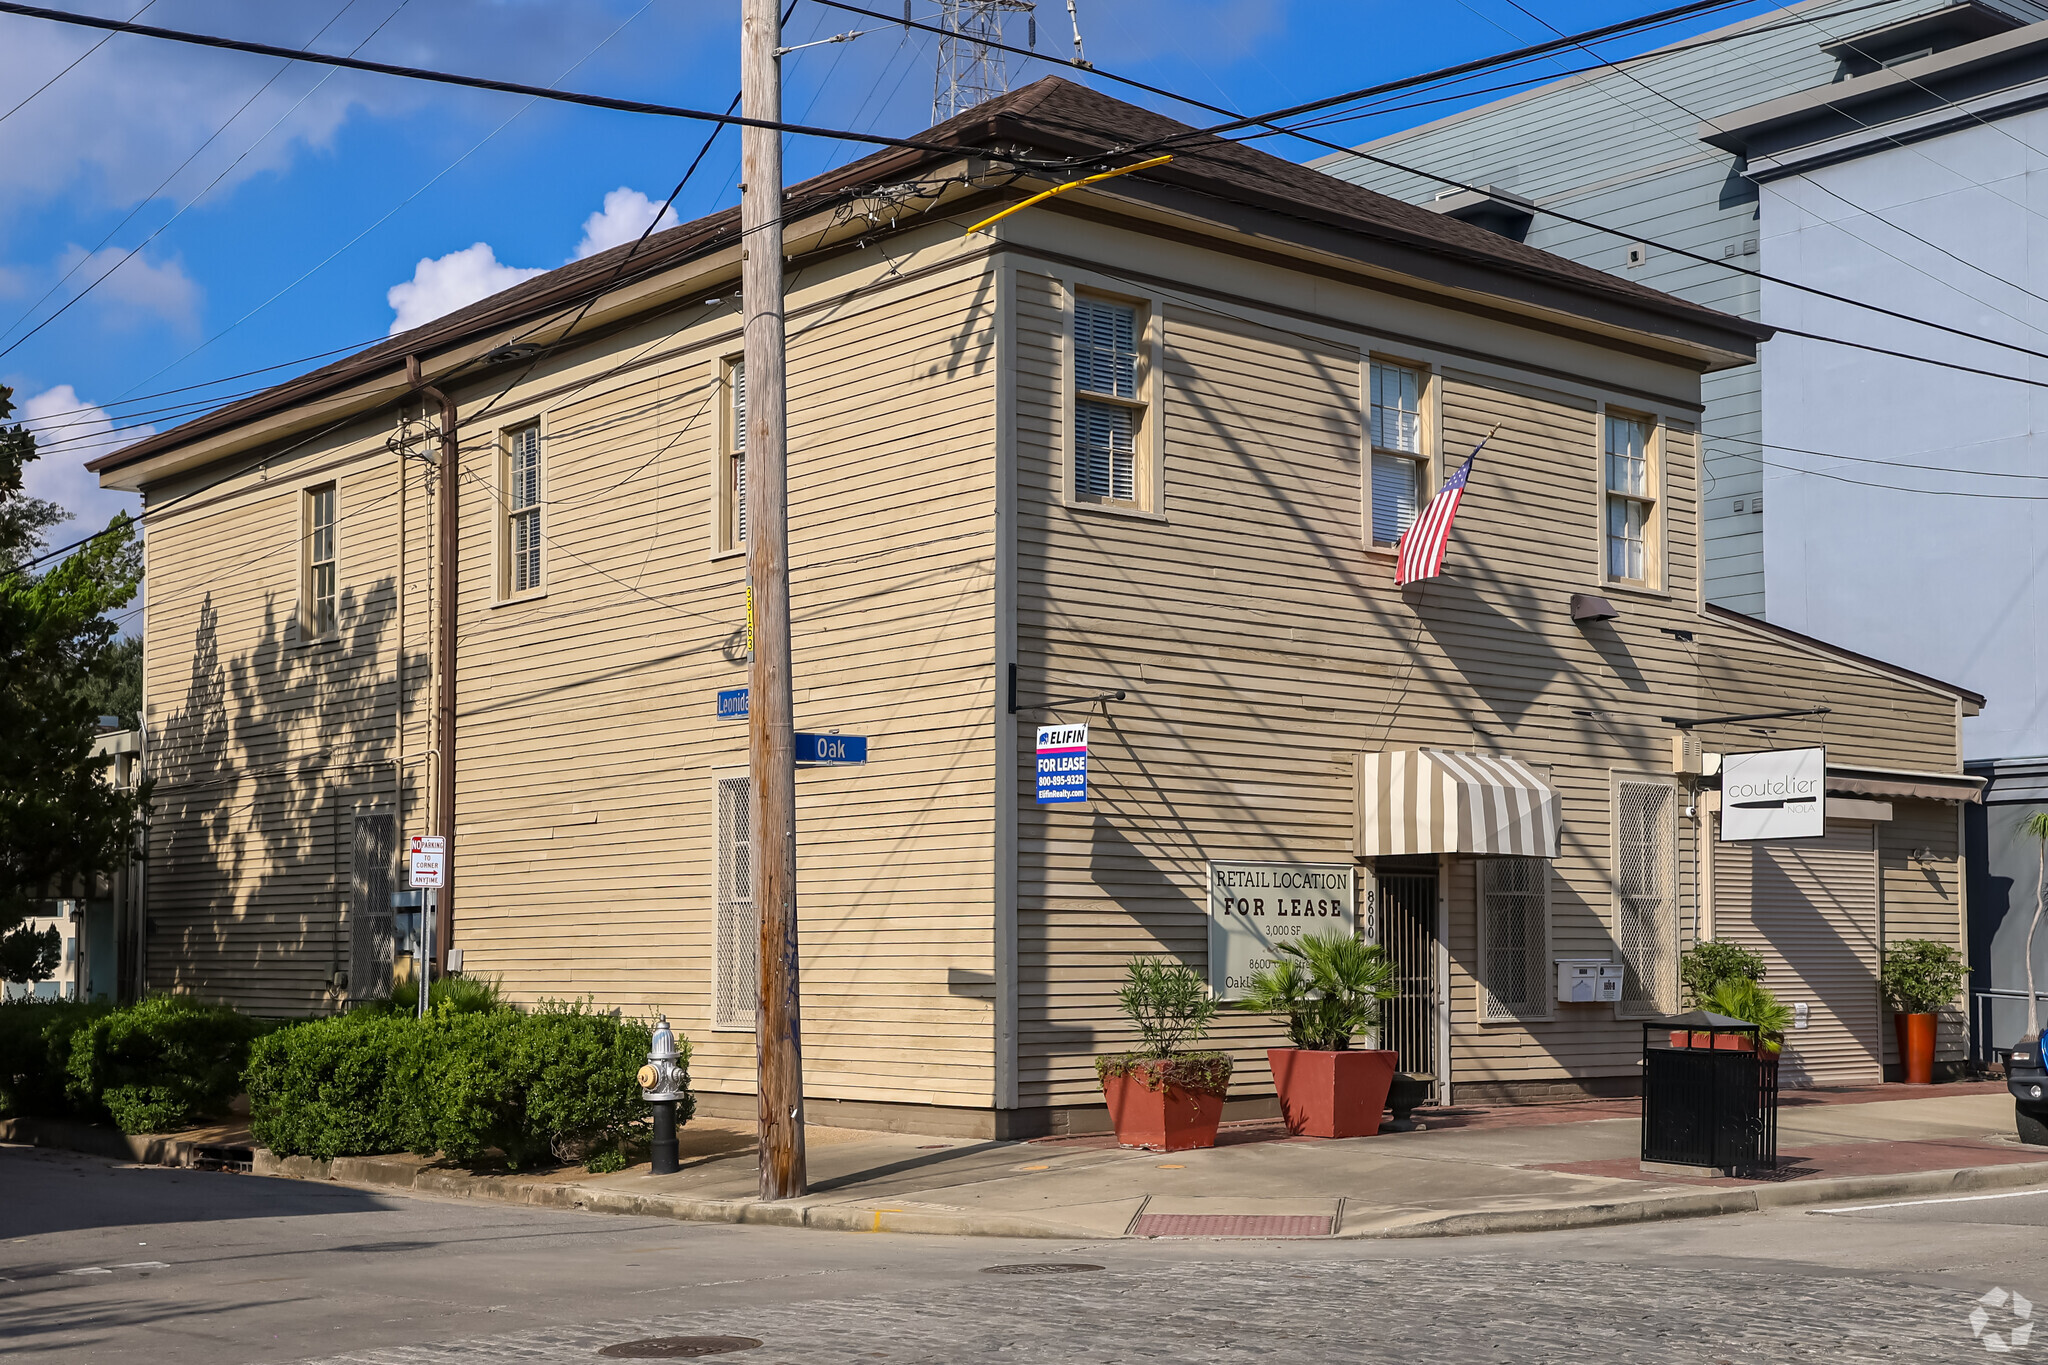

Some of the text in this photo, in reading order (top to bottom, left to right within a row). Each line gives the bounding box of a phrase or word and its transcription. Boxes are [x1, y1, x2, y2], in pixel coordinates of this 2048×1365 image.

[719, 693, 749, 714] Leonida
[1050, 730, 1085, 744] ELIFIN
[817, 738, 845, 758] Oak
[1038, 757, 1085, 772] FOR LEASE
[1039, 775, 1084, 786] 800-895-9329
[1729, 775, 1817, 798] coutelier
[1039, 790, 1084, 799] ElifinRealty.com
[1788, 805, 1815, 814] NOLA
[412, 840, 421, 849] NO
[1217, 871, 1347, 889] RETAIL LOCATION
[1225, 898, 1341, 917] FOR LEASE
[1266, 925, 1290, 936] 3,000
[1249, 959, 1270, 969] 8600
